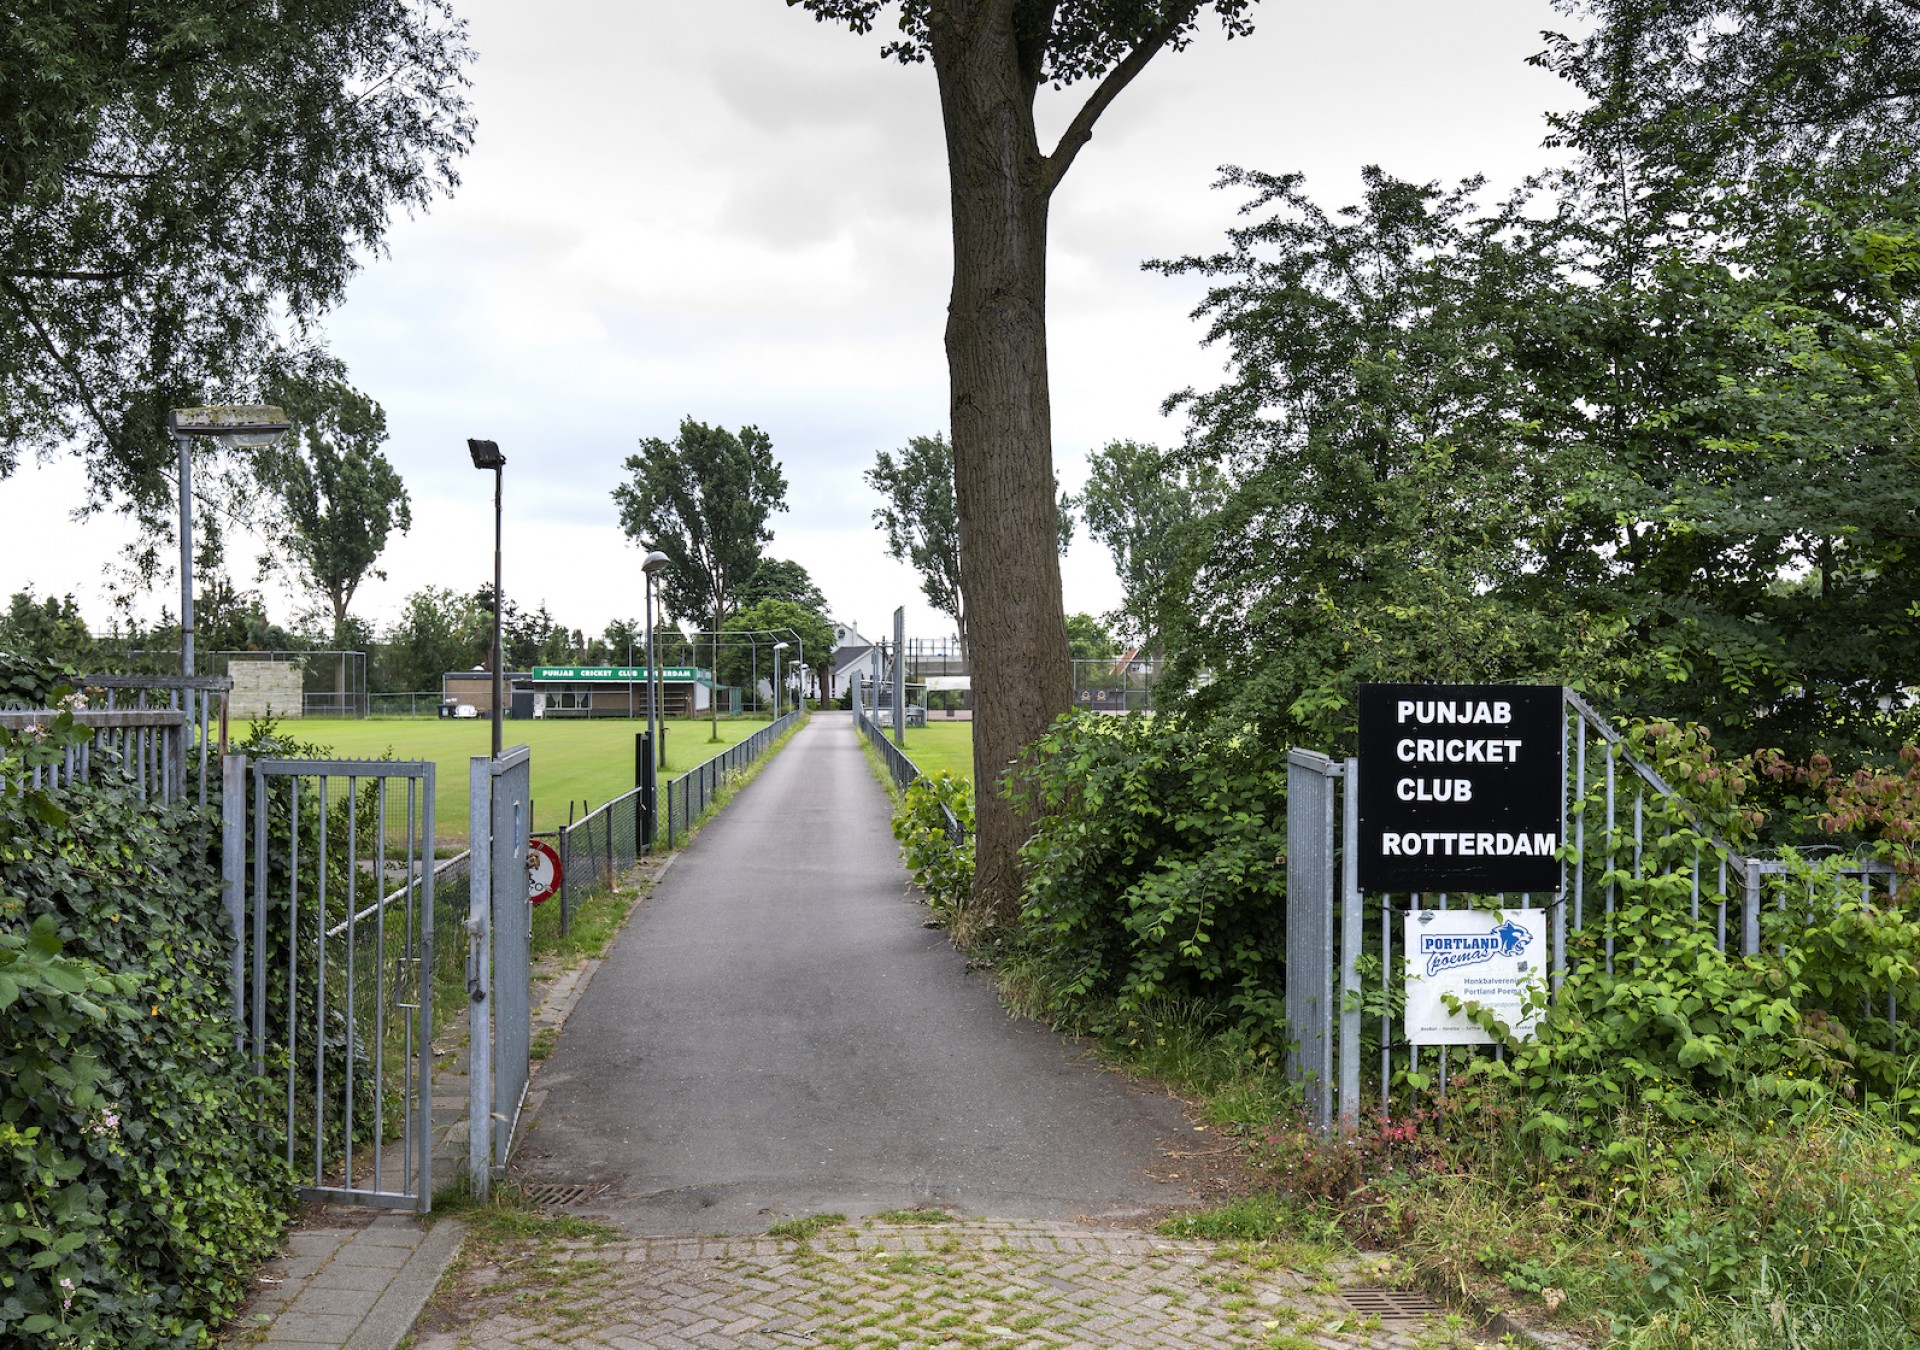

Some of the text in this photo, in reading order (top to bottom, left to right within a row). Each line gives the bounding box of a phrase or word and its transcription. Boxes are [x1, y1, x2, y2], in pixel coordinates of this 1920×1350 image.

[542, 669, 575, 677] PUNJAB
[580, 669, 613, 677] CRICKET
[1397, 701, 1512, 724] PUNJAB
[1396, 739, 1522, 763] CRICKET
[1396, 778, 1472, 802] CLUB
[1382, 832, 1557, 857] ROTTERDAM
[1425, 938, 1499, 950] PORTLAND
[1463, 987, 1495, 995] Portland
